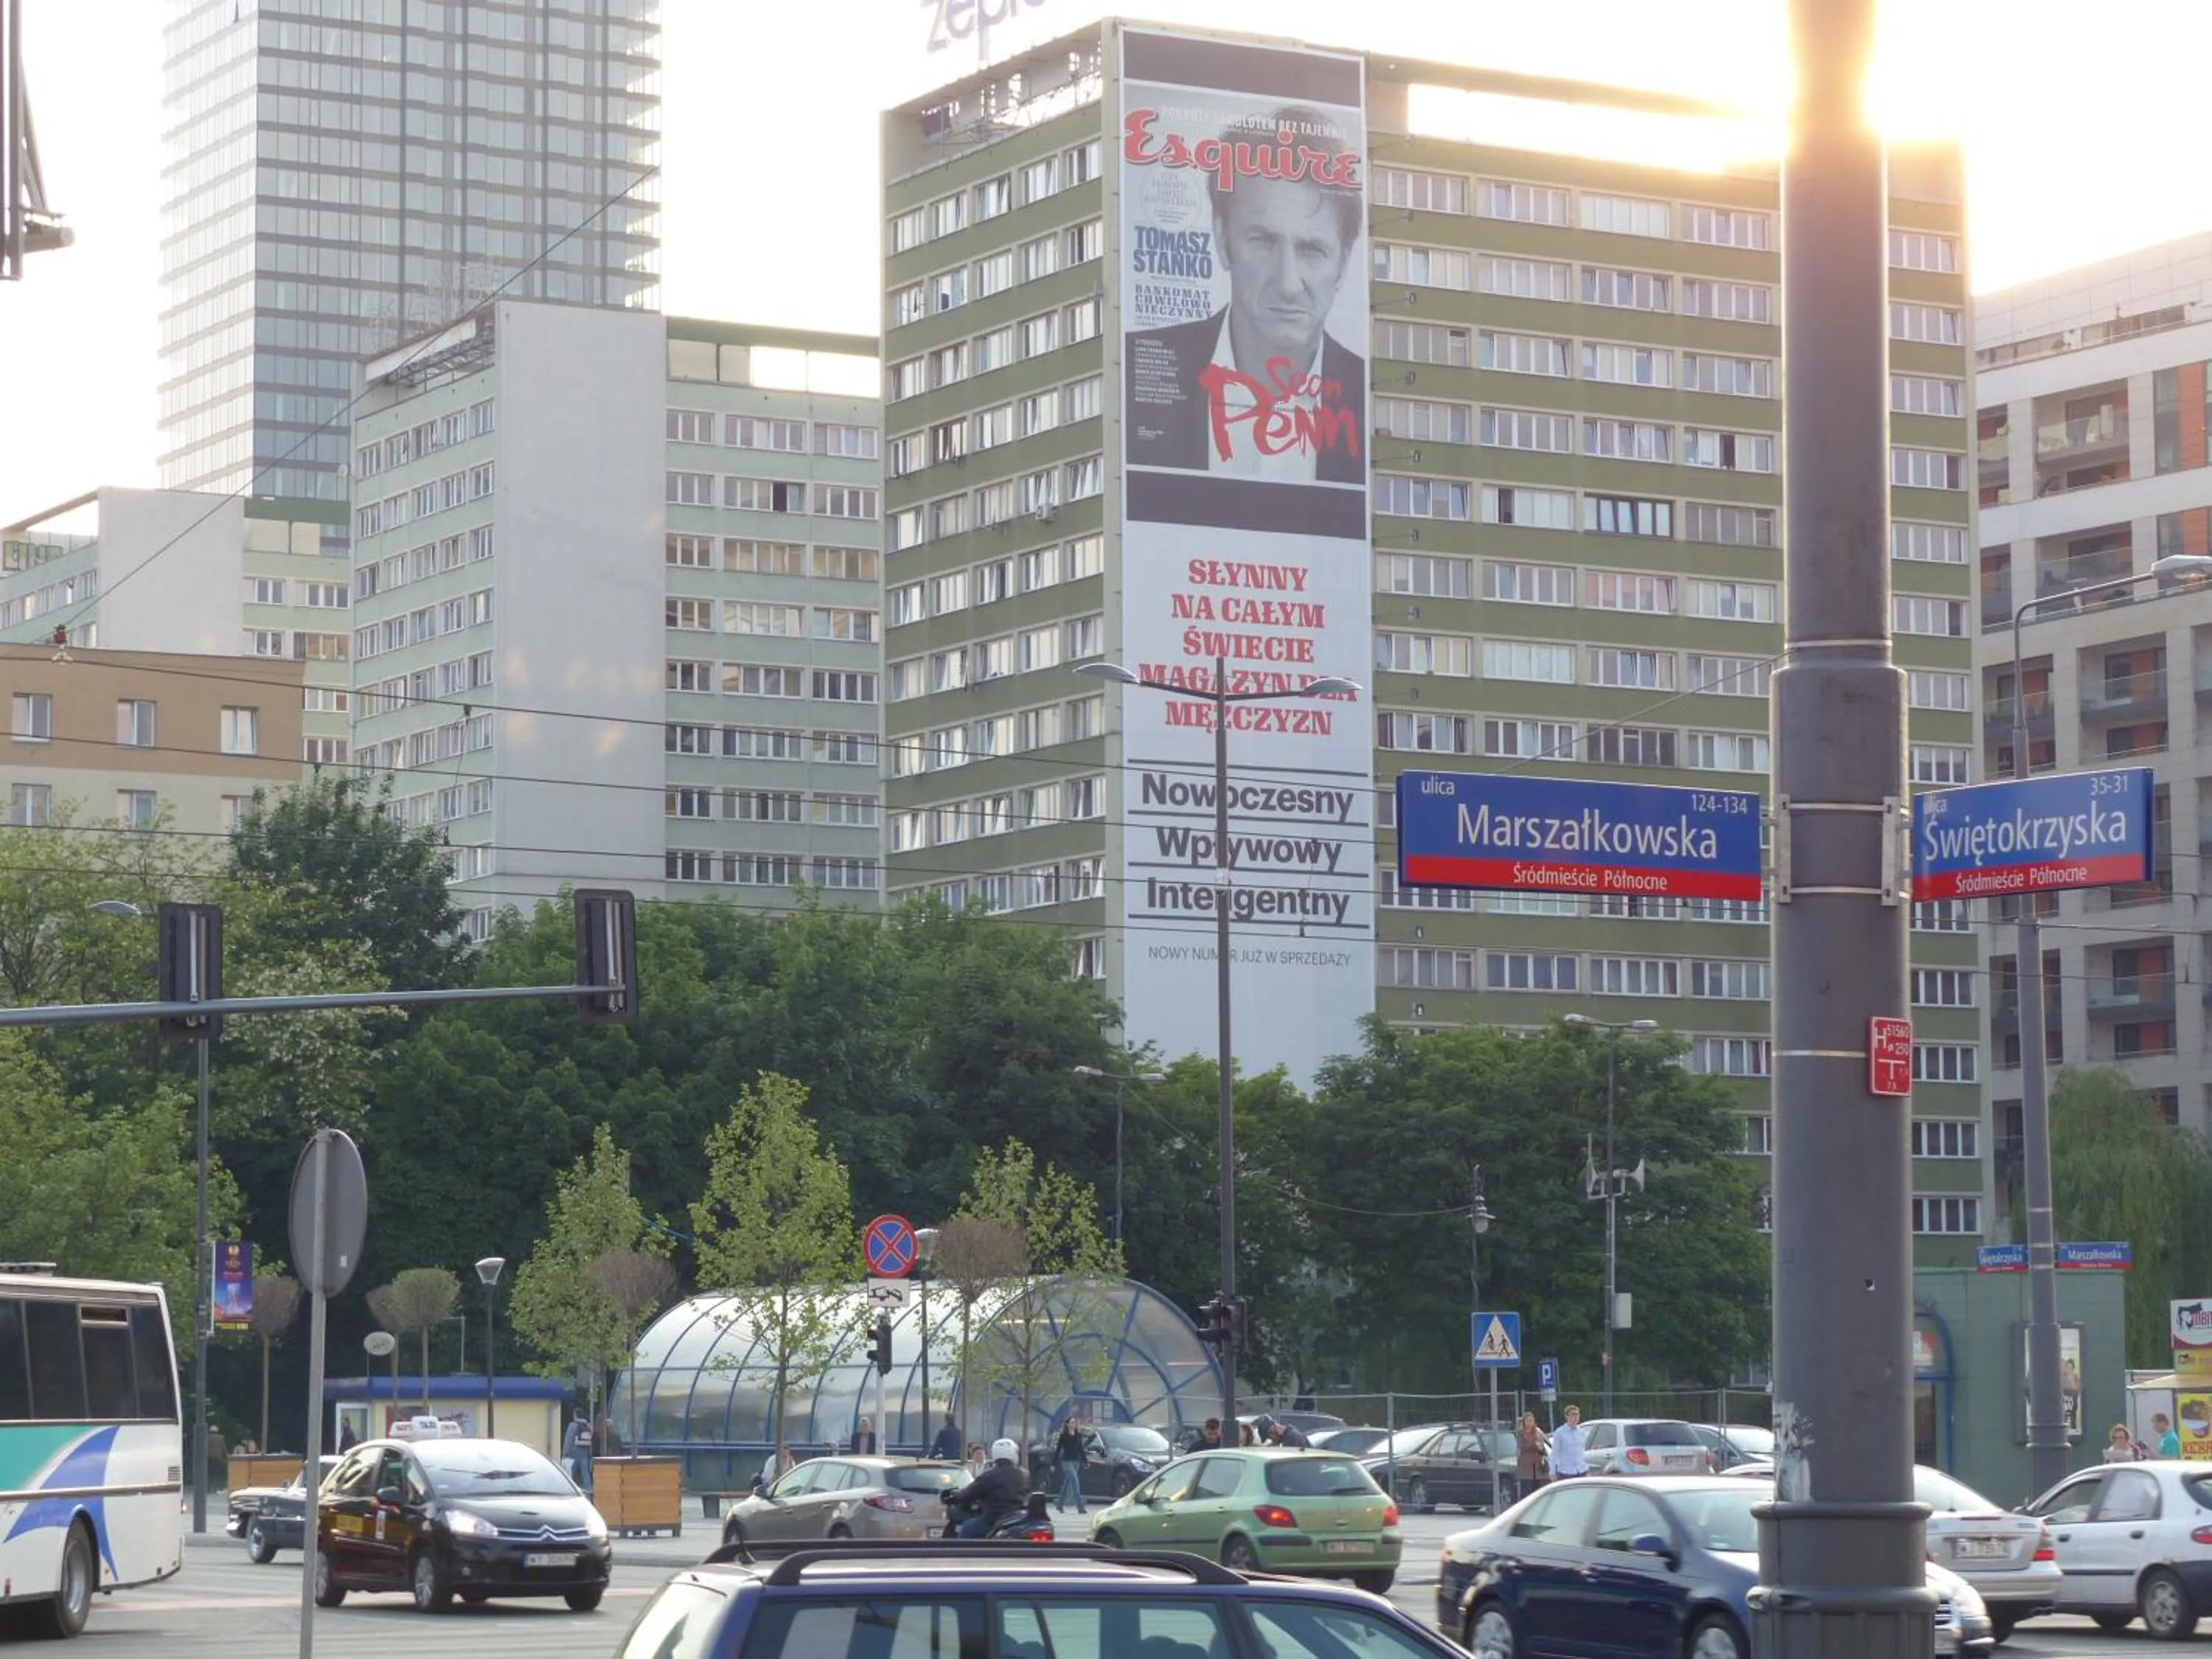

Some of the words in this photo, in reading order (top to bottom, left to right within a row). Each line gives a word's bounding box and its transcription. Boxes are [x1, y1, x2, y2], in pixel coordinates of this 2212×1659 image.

[1124, 108, 1363, 192] Esquire
[1134, 226, 1211, 256] TOMASZ
[1135, 284, 1210, 299] BANKOMAT
[1188, 560, 1308, 591] SŁYNNY
[1171, 594, 1215, 621] NA
[1221, 597, 1325, 629] CAŁYM
[1183, 625, 1315, 663] ŚWIECIE
[1142, 772, 1354, 824] Nowoczesny
[1422, 776, 1455, 796] ulica
[1691, 793, 1747, 814] 124-134
[1924, 796, 1948, 815] ulica
[2090, 775, 2128, 796] 35-31
[1457, 801, 1717, 860] Marszałkowska
[1925, 800, 2126, 866] Świętokrzyska
[1156, 826, 1343, 873] Wpywowy
[1514, 863, 1597, 887] Śródmieście
[1604, 872, 1668, 891] Północne
[1955, 869, 2024, 894] Śródmieście
[2029, 866, 2087, 885] Północne
[1149, 946, 1189, 959] NOWY
[1192, 947, 1237, 962] NUMR
[1266, 952, 1279, 964] W
[1876, 1027, 1887, 1049] H
[1543, 1364, 1551, 1386] P
